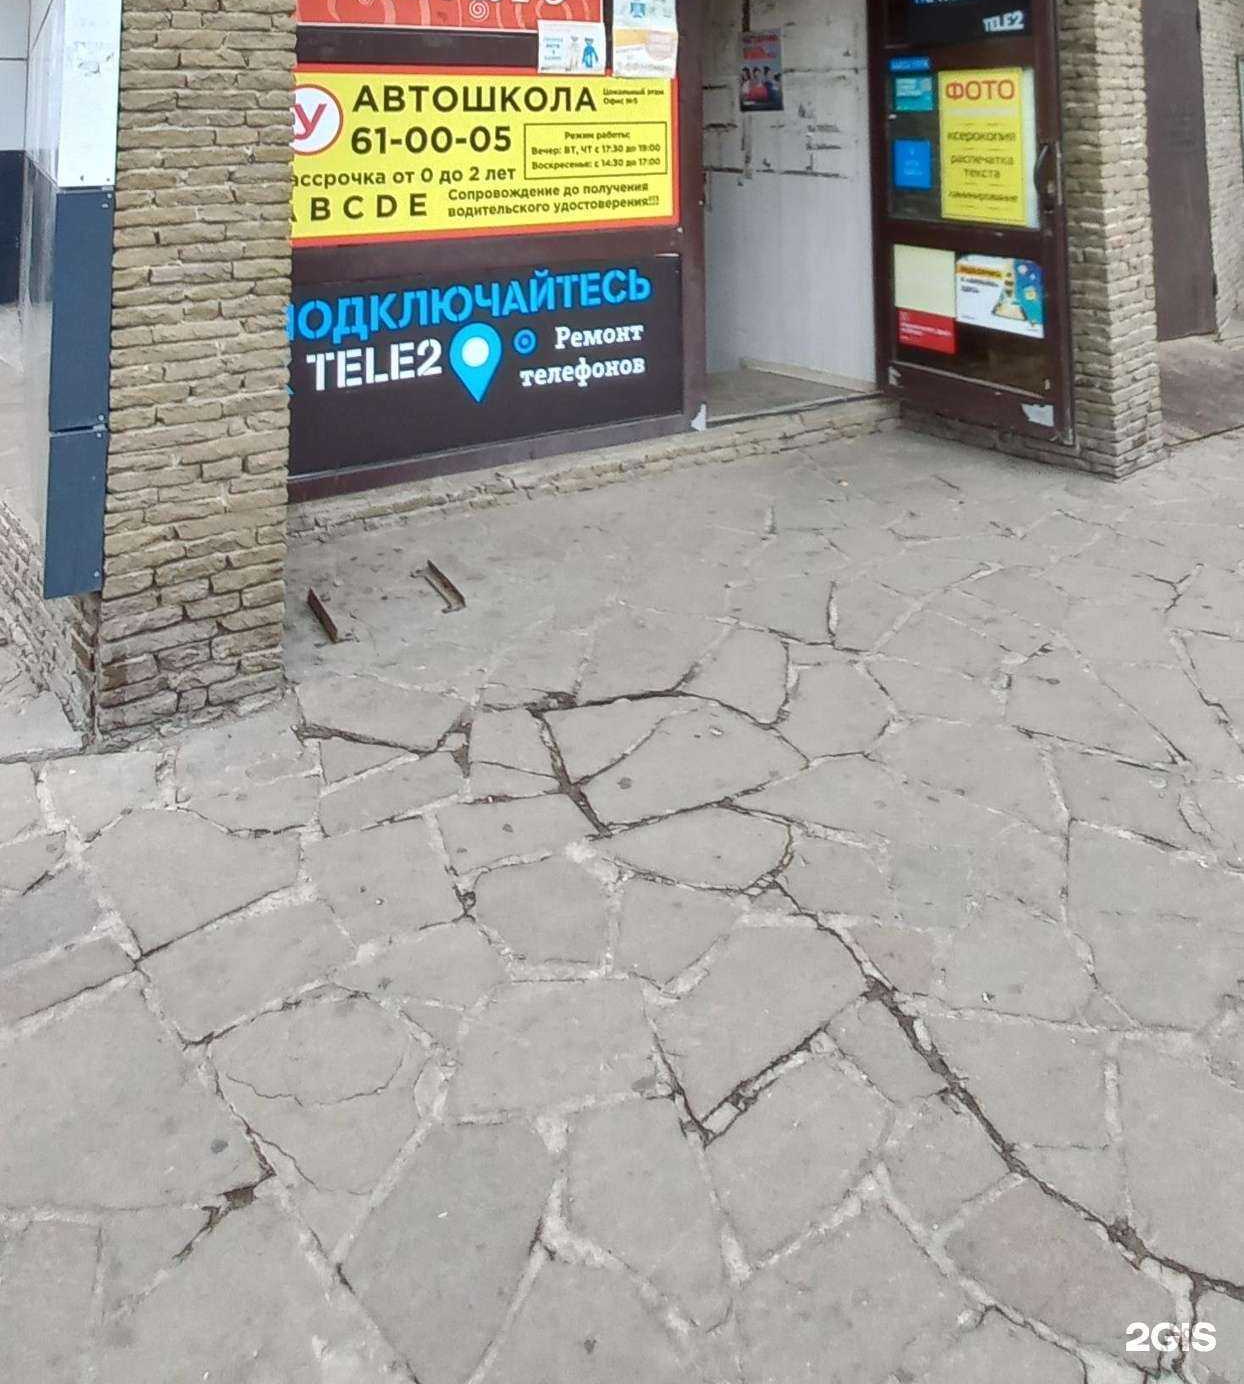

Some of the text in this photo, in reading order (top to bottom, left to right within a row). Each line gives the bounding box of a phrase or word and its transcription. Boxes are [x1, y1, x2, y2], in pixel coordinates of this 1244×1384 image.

[982, 10, 1024, 32] TELE2
[352, 84, 597, 113] АВТОШКОЛА
[945, 79, 1014, 101] ФОТО
[603, 97, 624, 105] Офис
[351, 125, 511, 154] 61-00-05
[564, 131, 631, 140] Режим работы:
[947, 131, 1016, 142] ксерокопия
[531, 147, 561, 156] Вечер:
[564, 146, 579, 155] ВТ,
[581, 145, 592, 154] ЧТ
[601, 144, 624, 153] 17:30
[601, 159, 624, 167] 14:30
[950, 155, 1014, 166] распечатка
[291, 166, 517, 189] ассрочка от 0 до 2 лет
[964, 168, 1000, 178] текста
[448, 182, 649, 202] Сопровождение до получения
[448, 200, 550, 219] водительского
[554, 323, 644, 350] Ремонт
[306, 338, 442, 392] TELE2
[519, 355, 646, 387] телефонов
